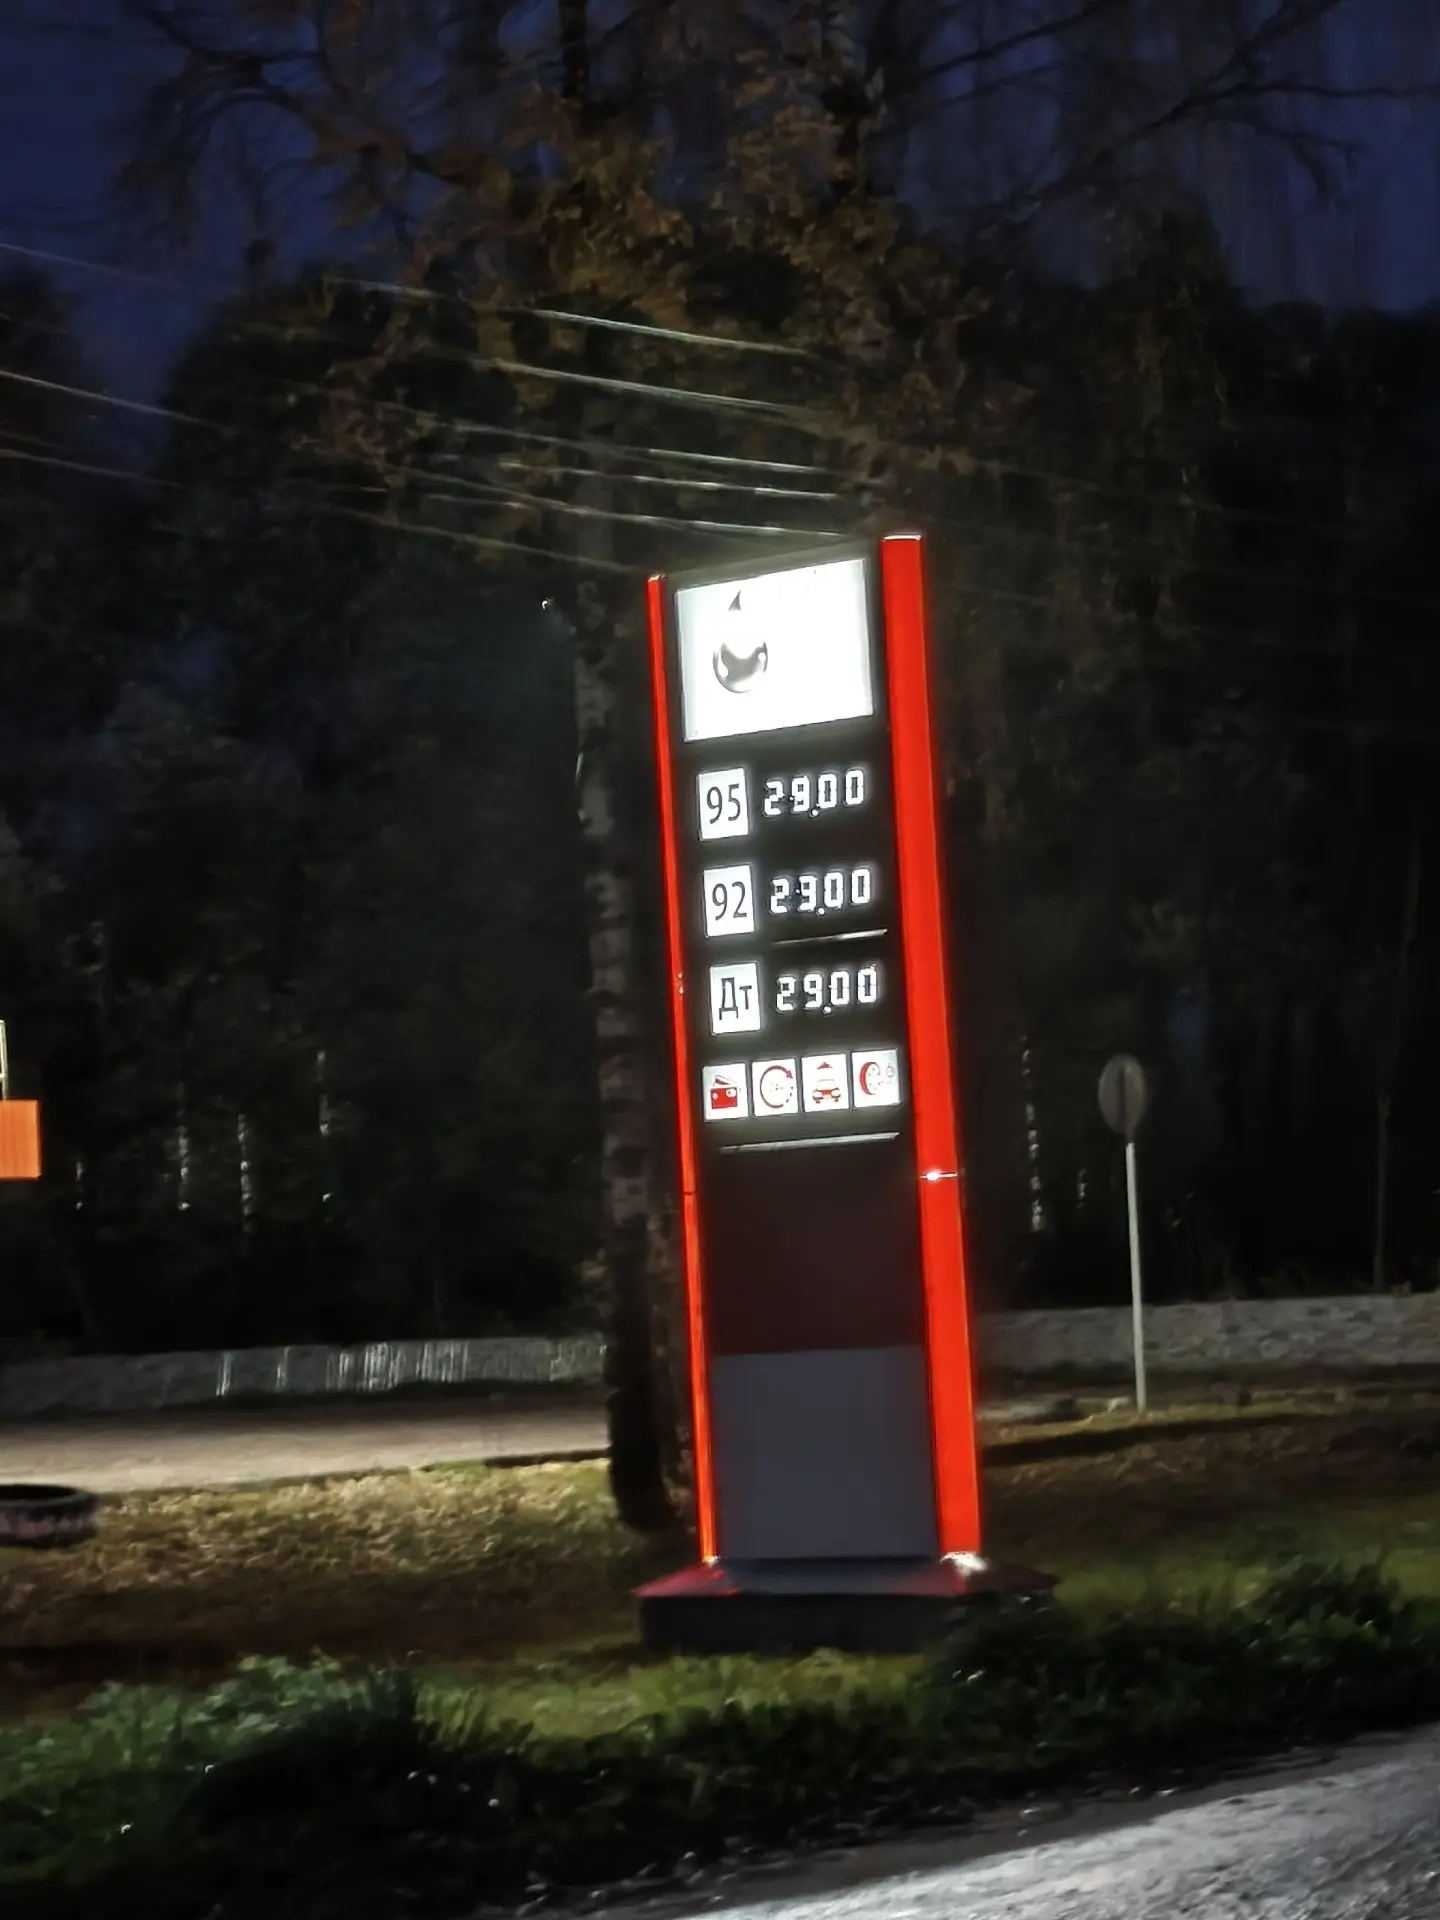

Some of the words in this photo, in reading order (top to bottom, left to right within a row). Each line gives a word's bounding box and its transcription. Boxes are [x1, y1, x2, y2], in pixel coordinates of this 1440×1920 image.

[706, 783, 741, 825] 95
[712, 881, 748, 921] 92
[719, 977, 753, 1020] Дт
[776, 967, 877, 1014] 29.00
